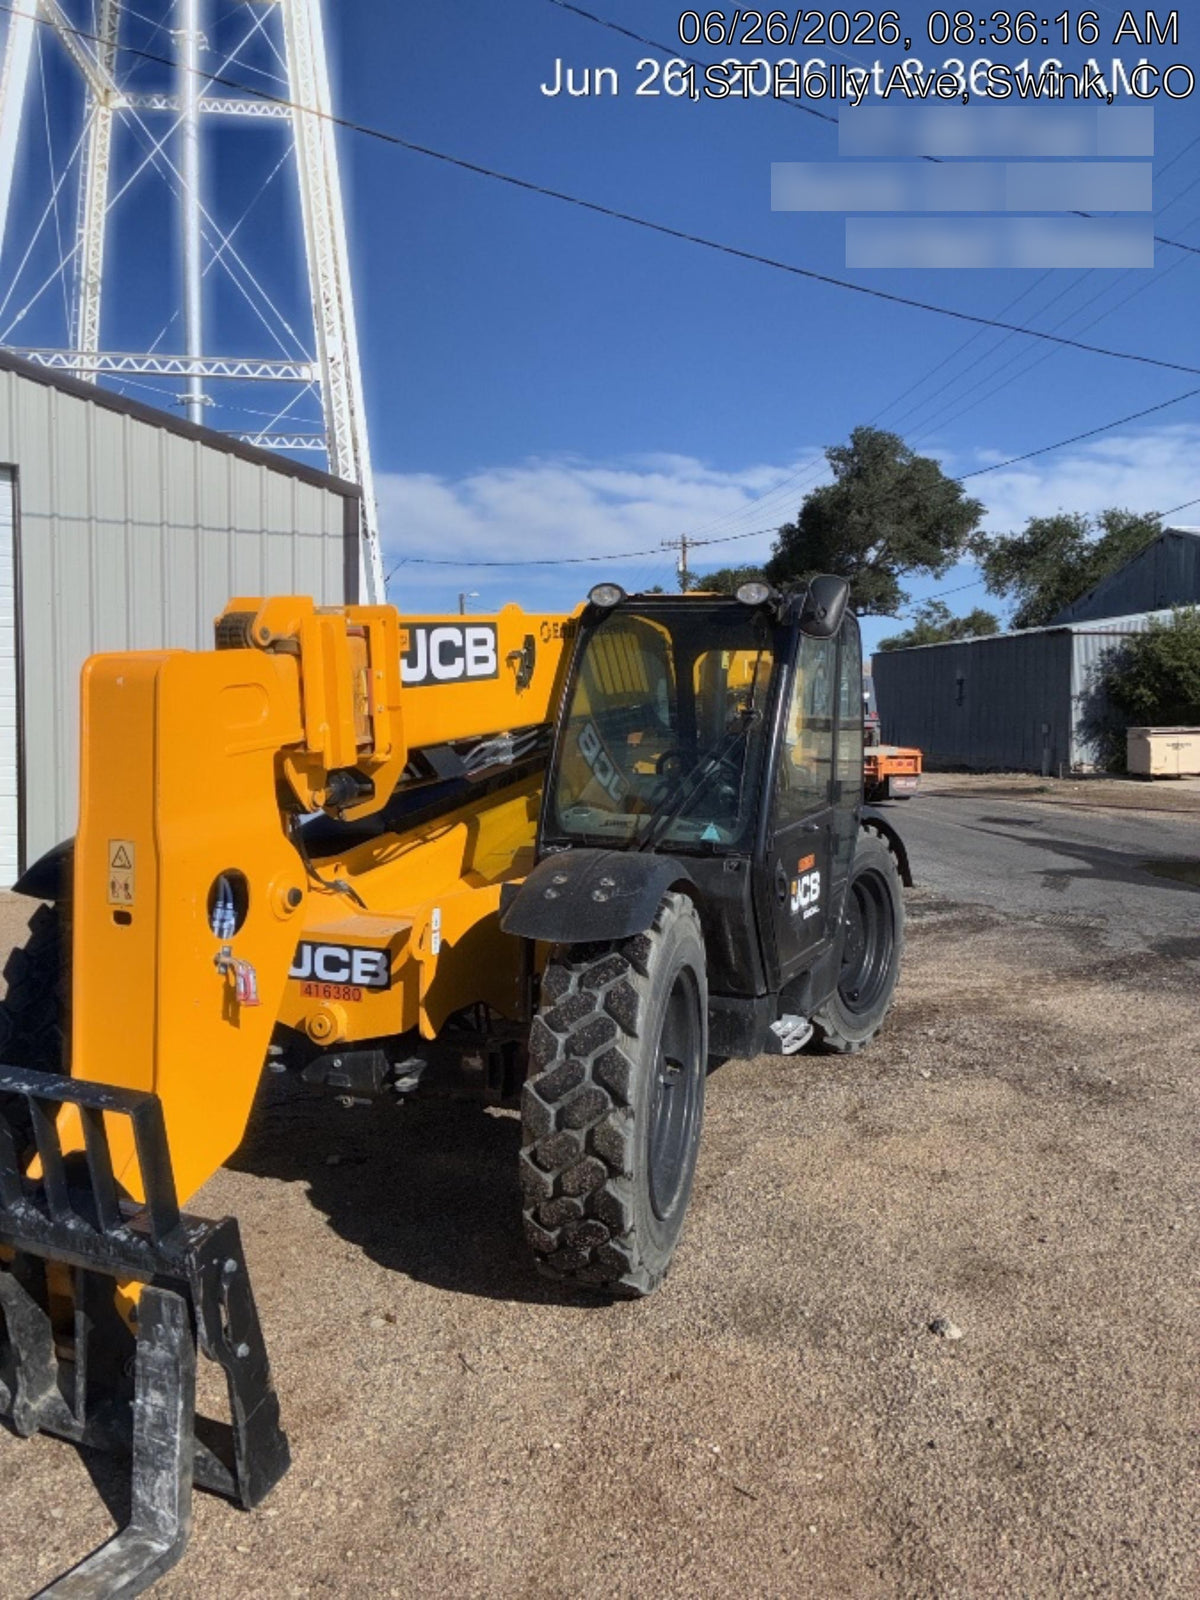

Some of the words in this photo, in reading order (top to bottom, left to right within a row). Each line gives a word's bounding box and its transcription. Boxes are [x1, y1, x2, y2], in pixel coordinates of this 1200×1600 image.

[401, 626, 496, 682] JCB
[790, 870, 820, 912] JCB
[288, 944, 389, 986] JCB
[303, 983, 362, 1002] 416380
